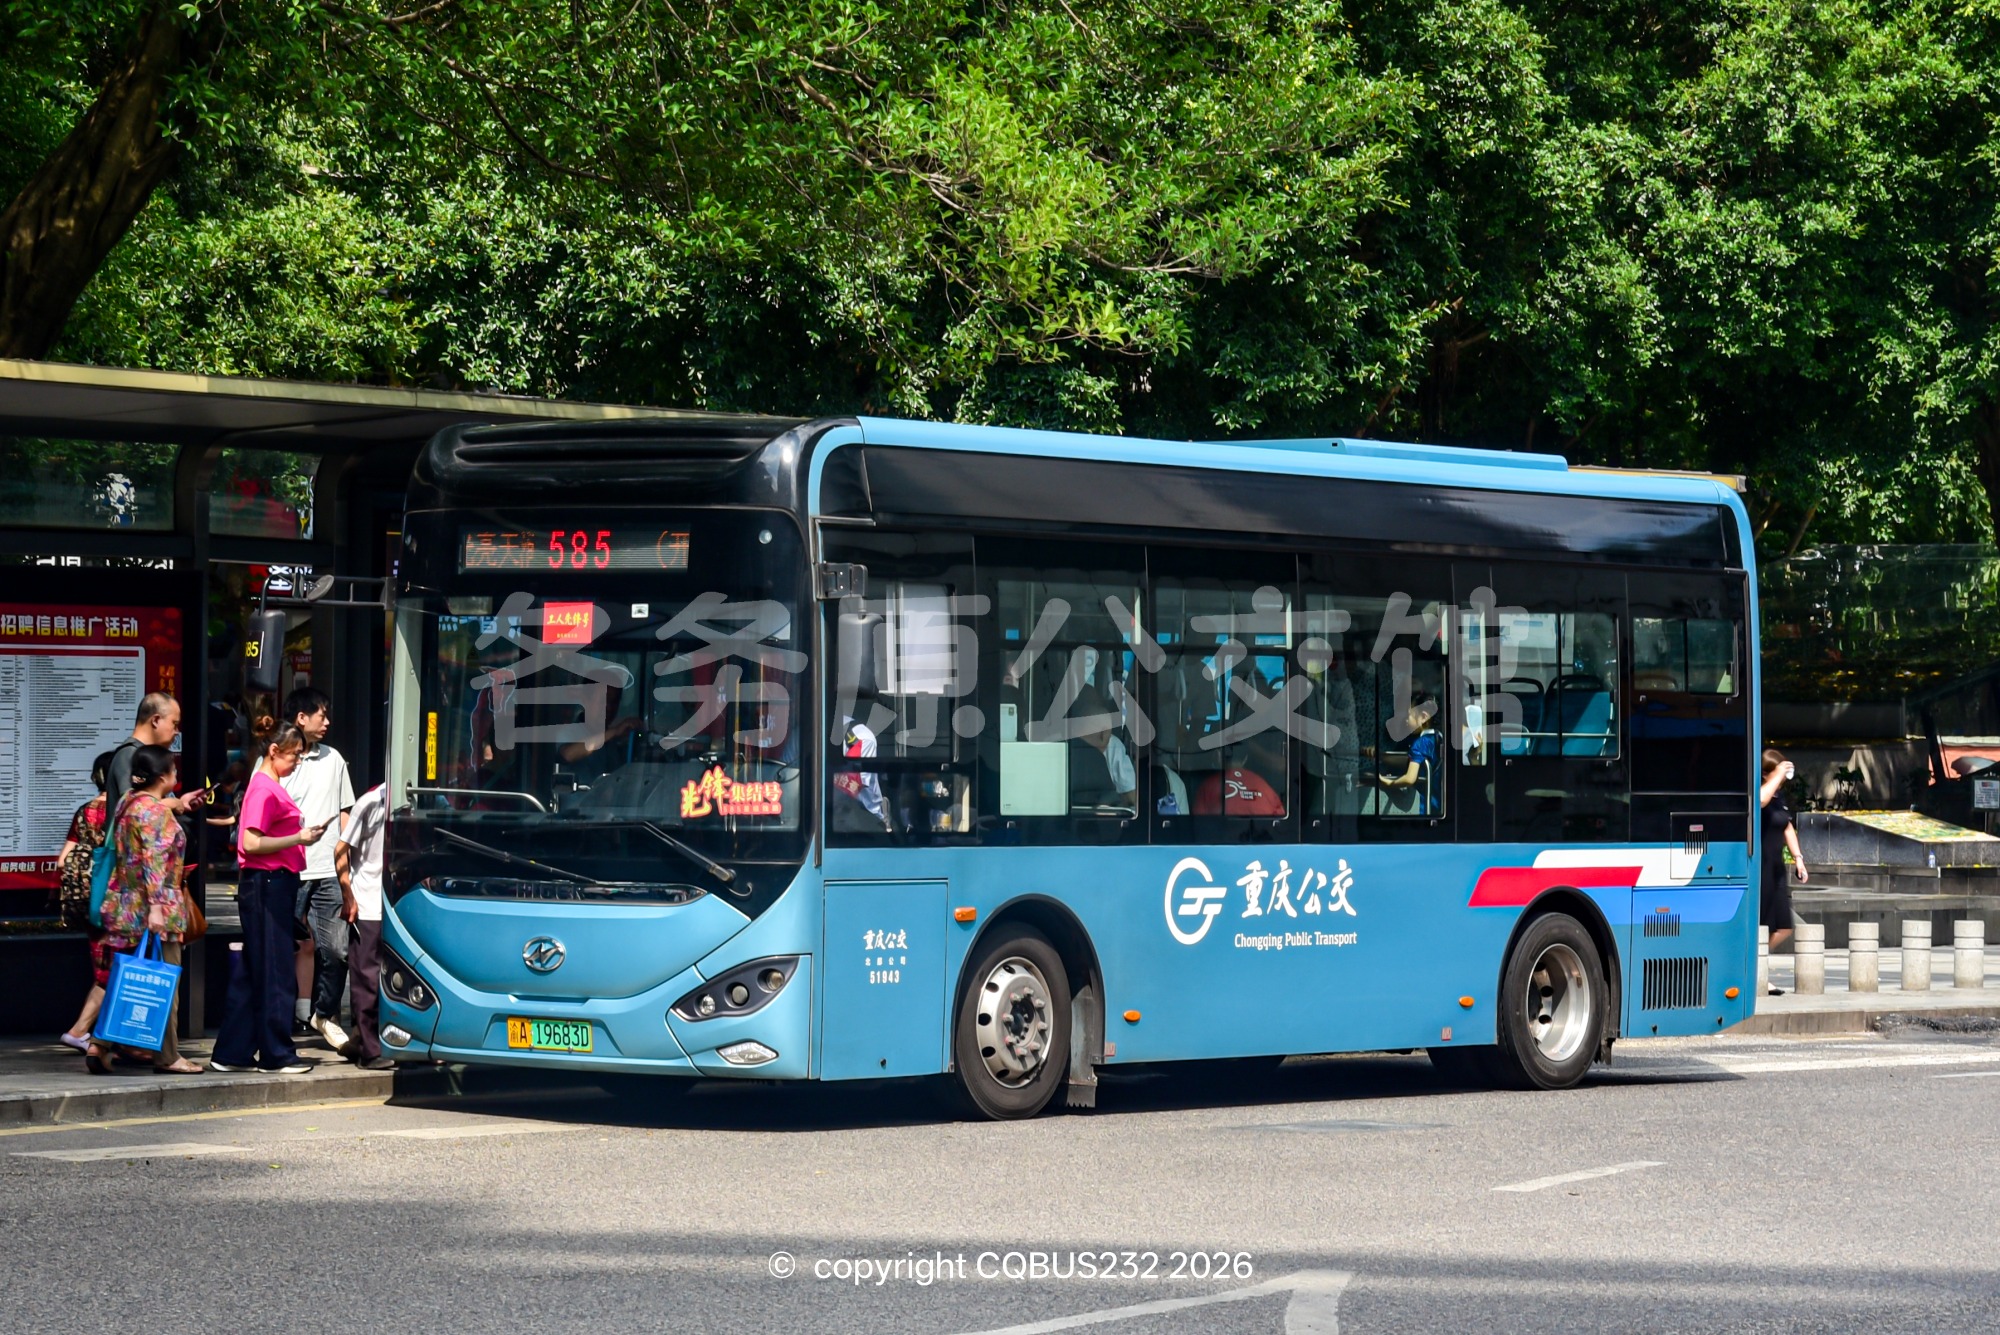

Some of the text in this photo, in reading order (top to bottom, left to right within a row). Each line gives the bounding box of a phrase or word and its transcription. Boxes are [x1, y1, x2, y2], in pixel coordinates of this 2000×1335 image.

[548, 531, 611, 568] 585
[1, 614, 139, 638] 招聘信息推广活动
[1236, 858, 1357, 919] 重庆公交
[863, 928, 908, 950] 重庆公交
[1235, 931, 1358, 950] Chongqing Public Transport
[869, 969, 900, 984] 51943
